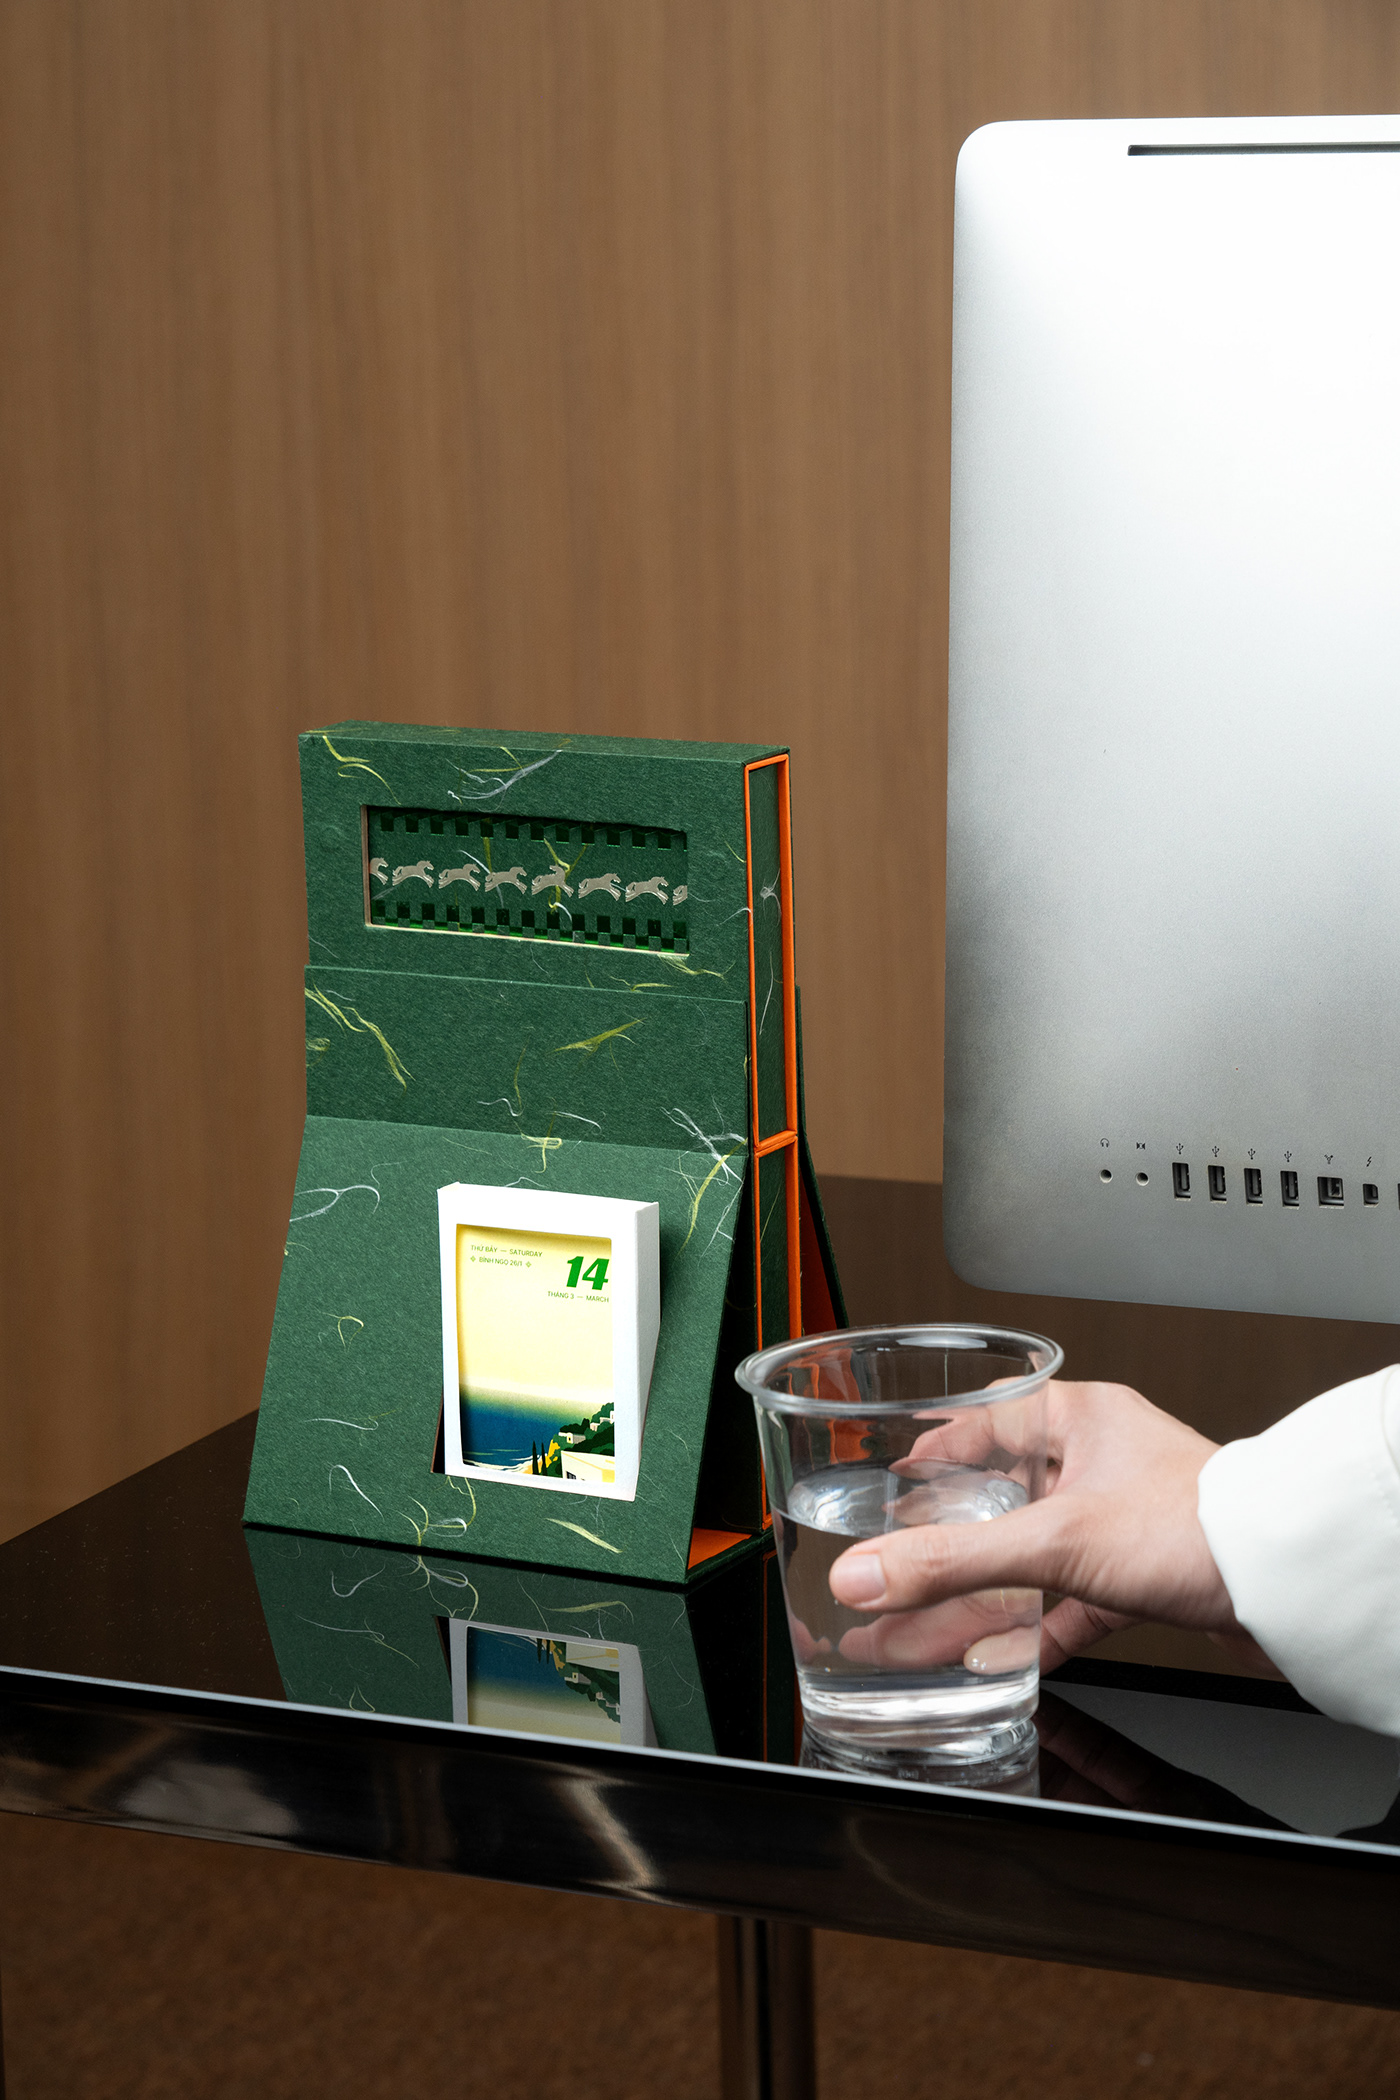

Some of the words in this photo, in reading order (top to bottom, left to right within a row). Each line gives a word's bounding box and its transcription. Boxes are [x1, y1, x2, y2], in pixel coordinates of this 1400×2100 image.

[509, 1248, 543, 1257] SATURDAY
[566, 1256, 610, 1291] 14
[586, 1295, 610, 1303] MARCH
